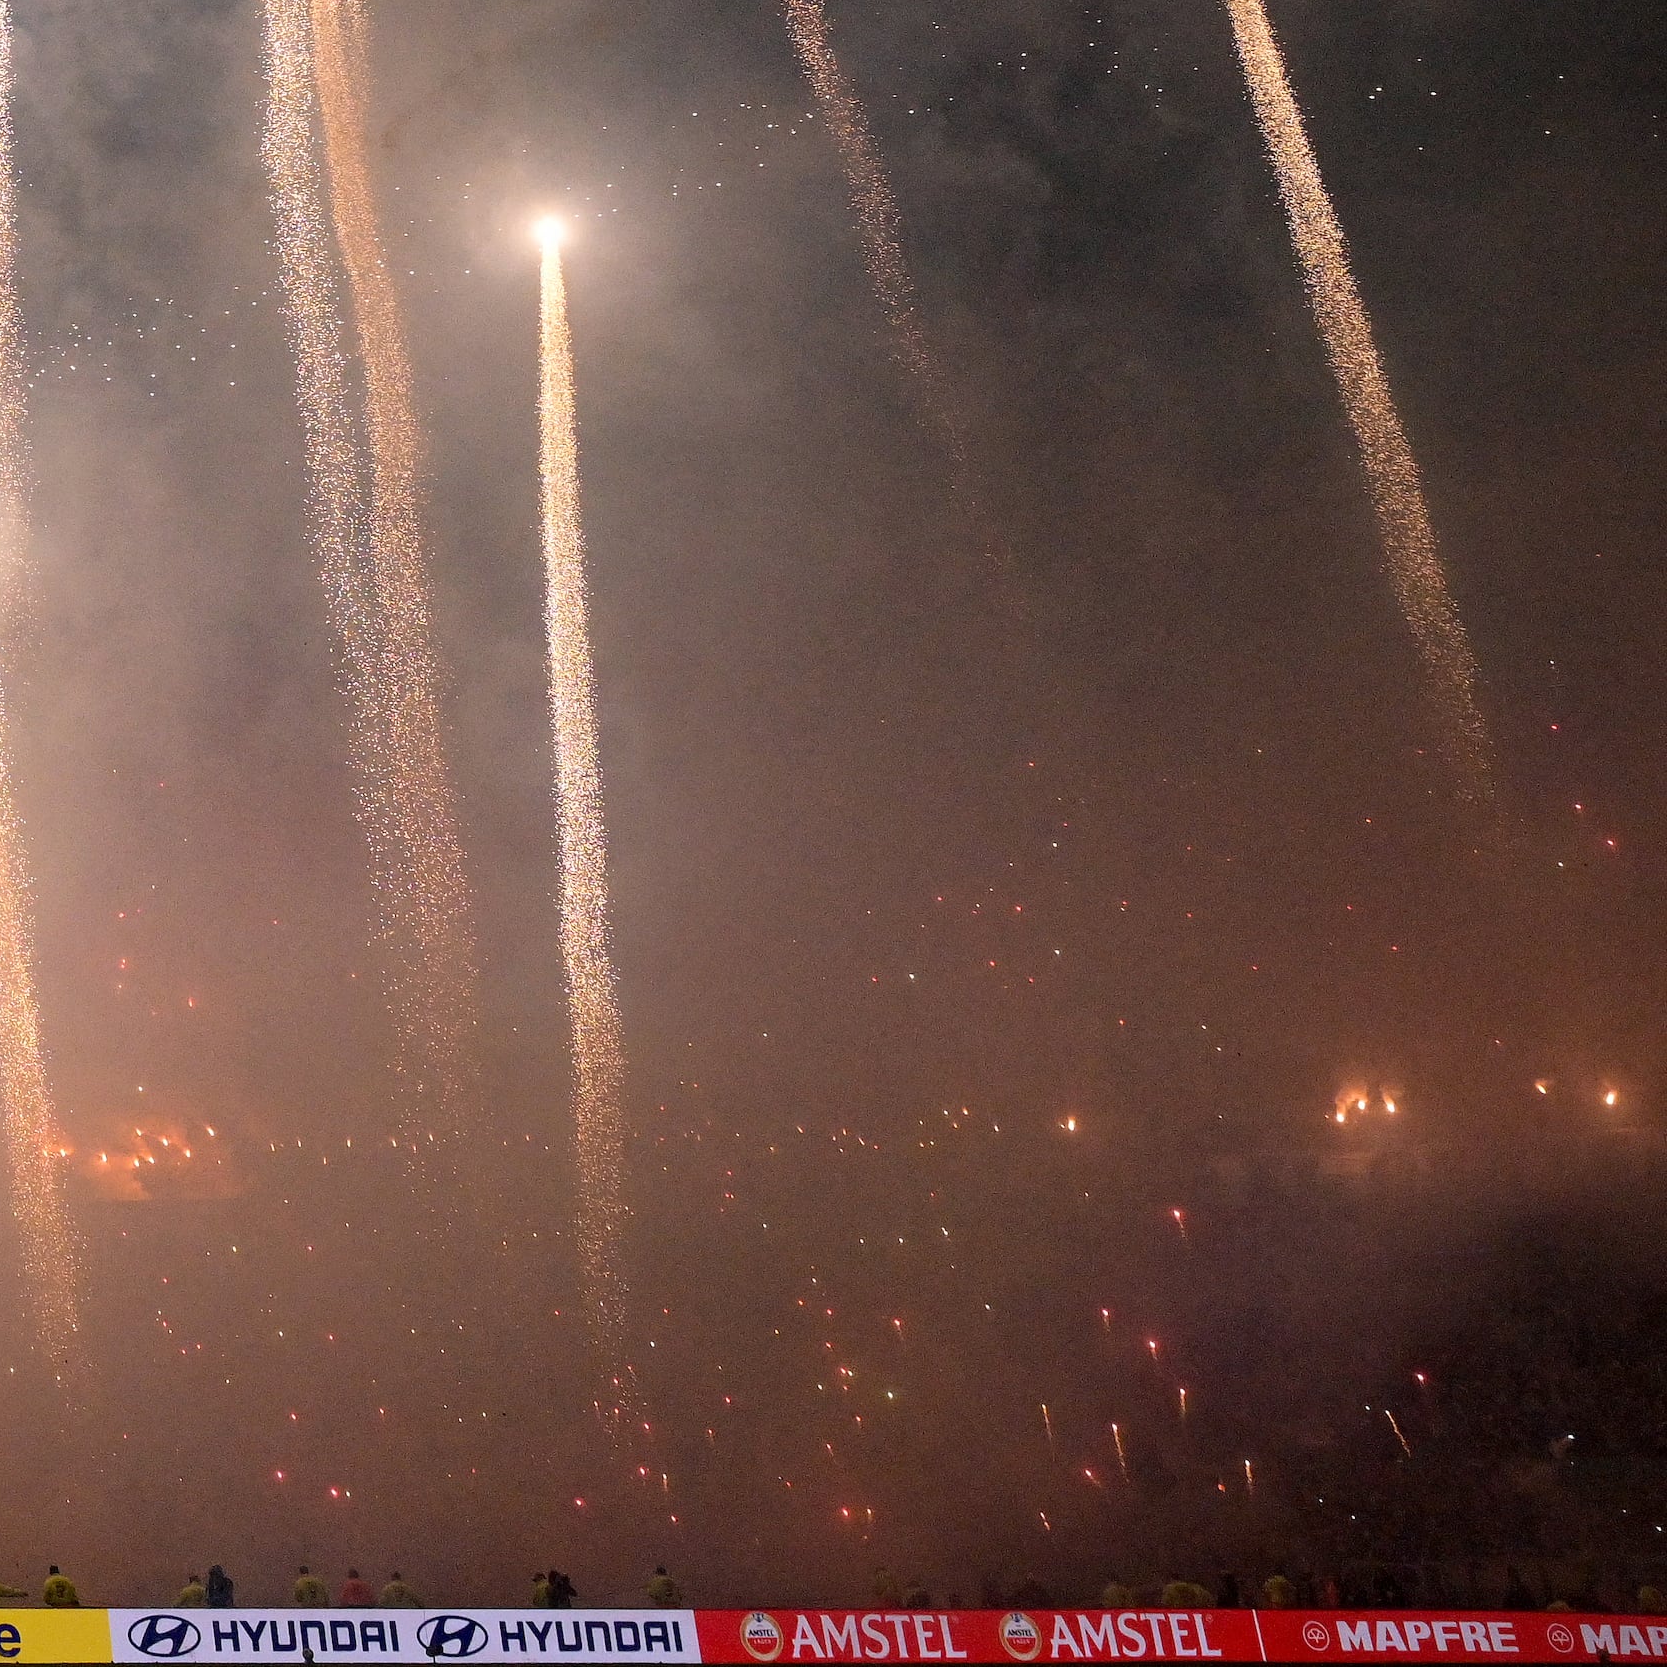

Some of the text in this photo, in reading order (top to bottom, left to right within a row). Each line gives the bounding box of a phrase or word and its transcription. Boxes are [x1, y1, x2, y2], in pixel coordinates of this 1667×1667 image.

[212, 1620, 400, 1653] HYUNDAI
[498, 1620, 684, 1653] HYUNDAI
[791, 1613, 968, 1659] AMSTEL
[1050, 1612, 1223, 1659] AMSTEL
[1339, 1619, 1521, 1653] MAPFRE
